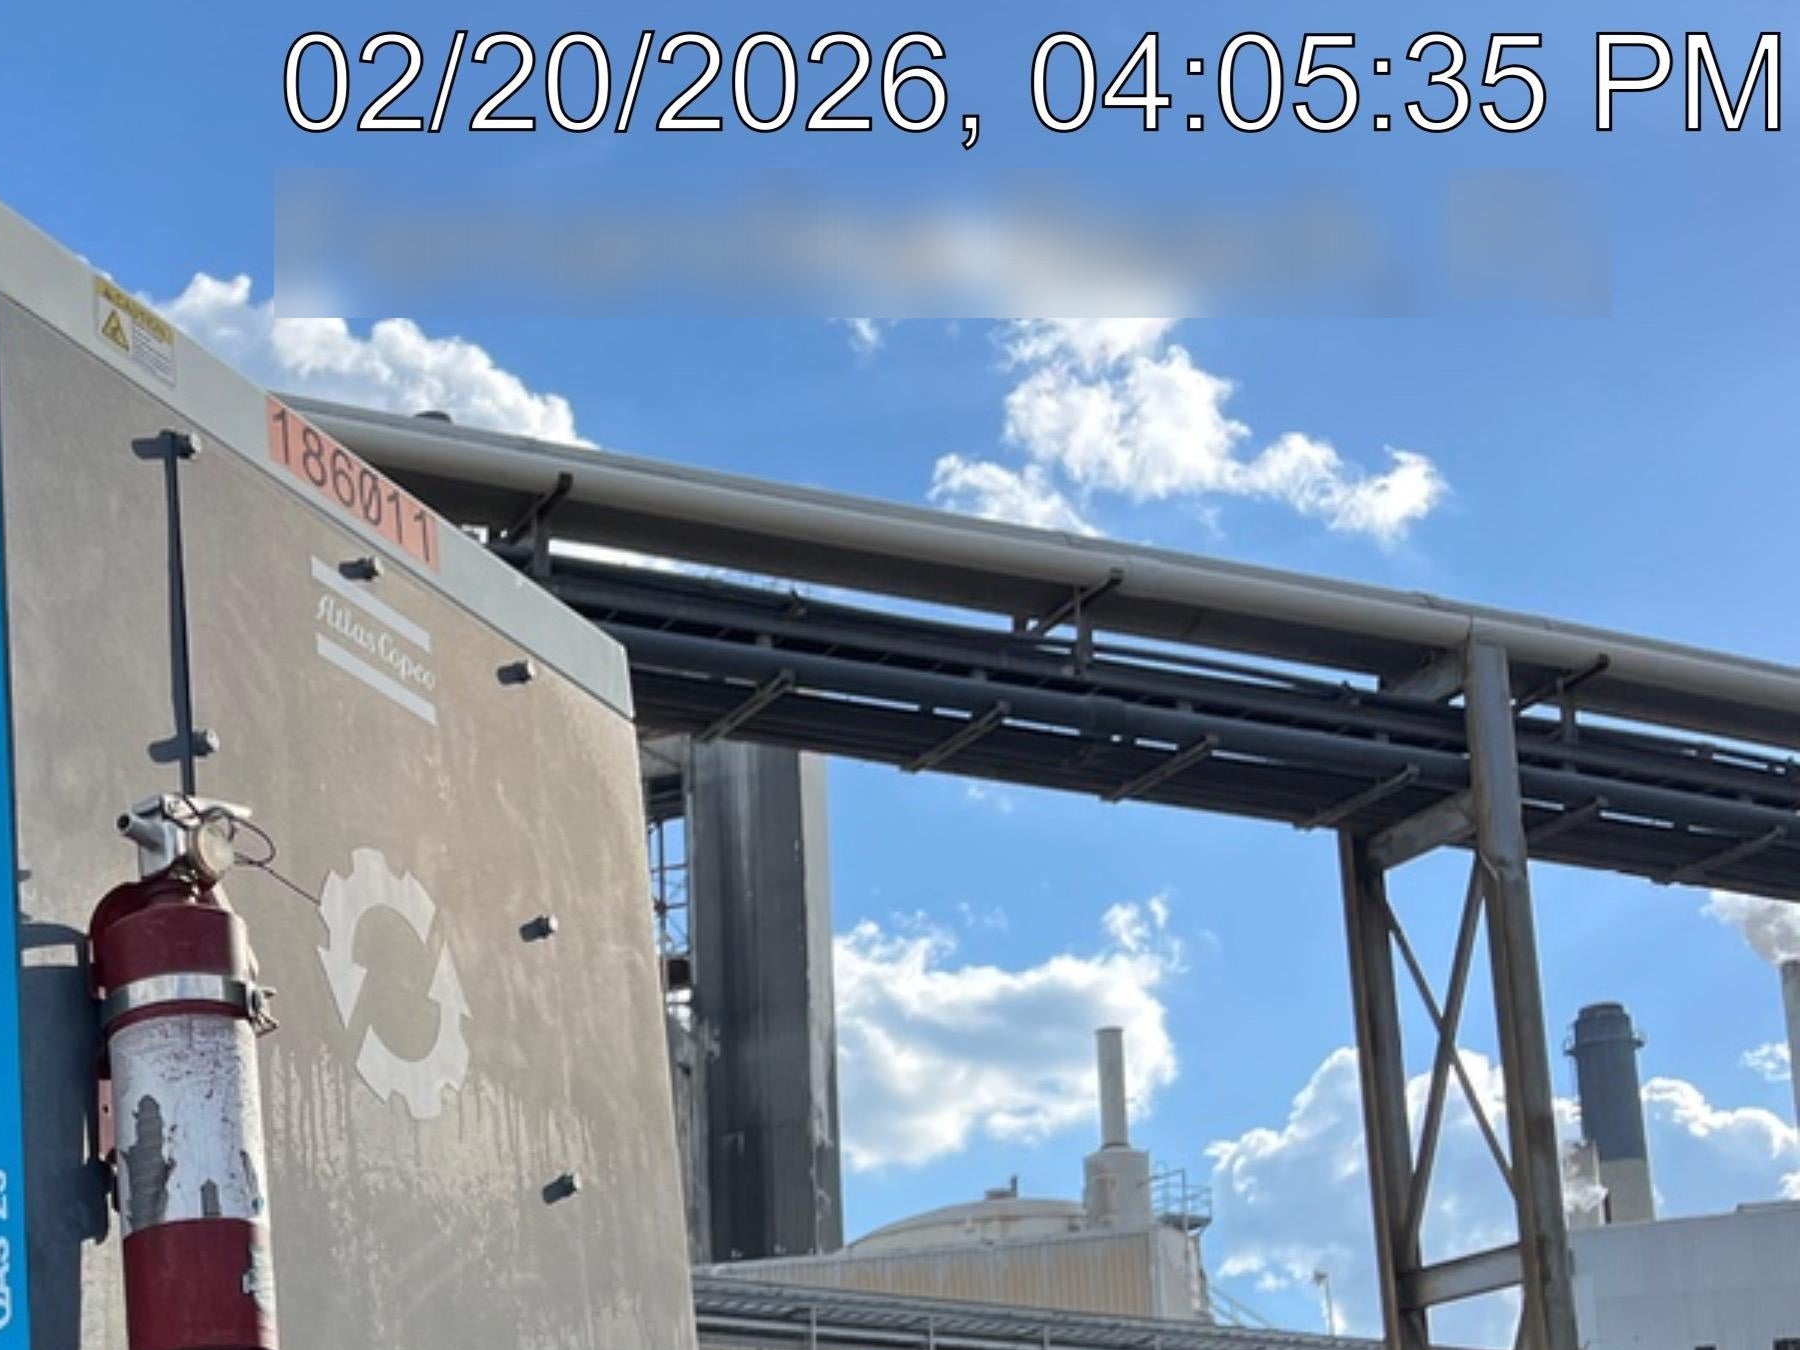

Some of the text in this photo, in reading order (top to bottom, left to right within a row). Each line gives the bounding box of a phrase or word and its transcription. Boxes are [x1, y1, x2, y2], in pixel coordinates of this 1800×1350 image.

[272, 407, 431, 563] 186011
[317, 594, 437, 692] Atlas Copco
